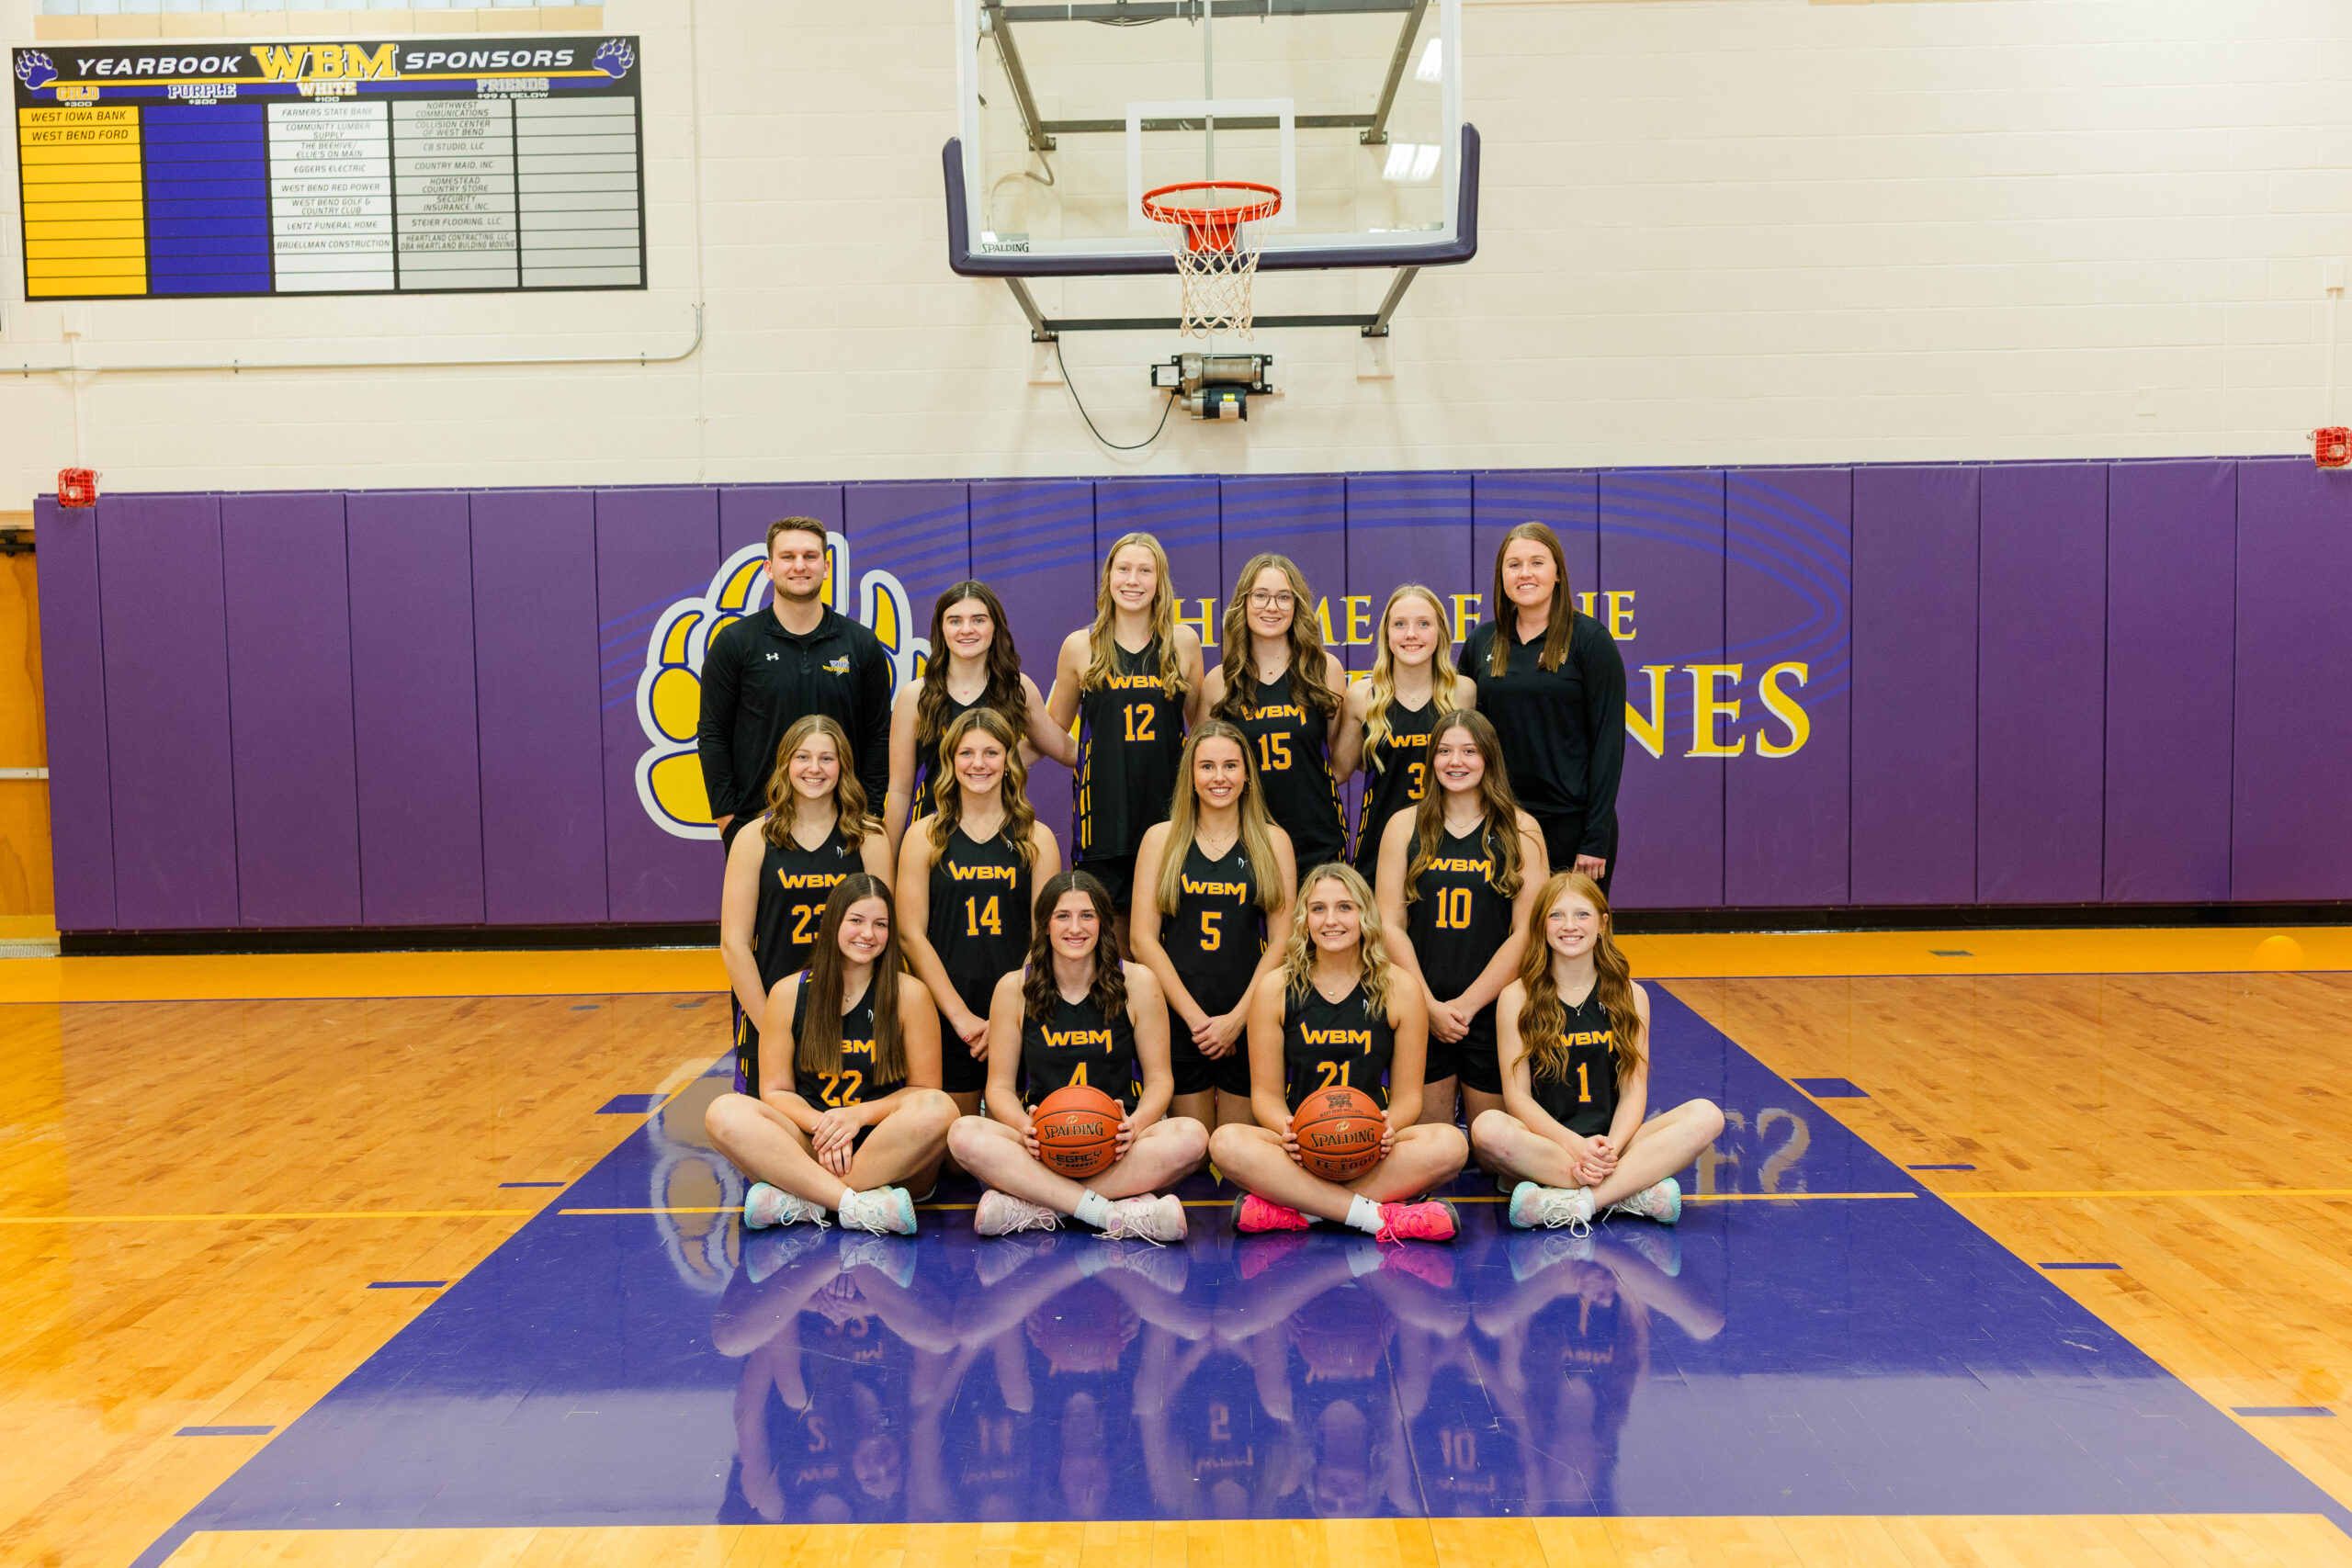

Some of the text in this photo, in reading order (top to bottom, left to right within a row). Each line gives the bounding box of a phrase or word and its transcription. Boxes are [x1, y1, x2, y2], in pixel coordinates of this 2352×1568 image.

[77, 43, 575, 81] YEARBOOK WBM SPONSORS
[56, 77, 549, 101] GOLD PURPLE WHITE FRIENDS
[282, 108, 322, 117] FARMERS
[415, 109, 490, 118] COMMUNICATIONS
[426, 101, 478, 109] NORTHWEST
[31, 110, 126, 122] WEST IOWA BANK
[286, 122, 371, 131] COMMUNITY LUMBER
[32, 130, 129, 141] WEST BEND FORD
[313, 131, 345, 140] SUPPLY
[319, 141, 357, 150] BEEHIVE/
[436, 142, 469, 152] STUDIO,
[294, 164, 367, 174] EGGERS ELECTRIC
[414, 162, 452, 170] COUNTRY
[307, 184, 329, 192] BEND
[350, 183, 380, 191] POWER
[436, 195, 477, 203] SECURITY
[301, 207, 338, 215] COUNTRY
[314, 221, 352, 230] FUNERAL
[355, 220, 378, 229] HOME
[412, 219, 440, 227] STEIER
[328, 240, 390, 249] CONSTRUCTION
[416, 242, 457, 250] HEARTLAND
[489, 240, 514, 248] MOVING
[982, 243, 1029, 254] SPALDING
[1174, 595, 1374, 648] HME
[1123, 704, 1156, 742] 12
[1240, 705, 1306, 727] WBM
[1386, 733, 1431, 749] WB
[1258, 732, 1292, 772] 15
[1408, 762, 1425, 799] 3
[948, 860, 1016, 890] WBM
[1426, 855, 1493, 883] WBM
[777, 867, 847, 889] WBM
[1180, 873, 1247, 906] WBM
[965, 895, 1001, 936] 14
[1435, 887, 1472, 930] 10
[1200, 911, 1223, 952] 5
[1041, 1024, 1113, 1055] WBM
[1300, 1021, 1372, 1055] WBM
[841, 1039, 876, 1064] BM
[1316, 1061, 1351, 1090] 21
[1577, 1062, 1591, 1102] 1
[818, 1069, 863, 1108] 22
[1045, 1122, 1103, 1139] SPALDING
[1311, 1128, 1375, 1147] SPALDING
[1048, 1150, 1102, 1163] LEGACY
